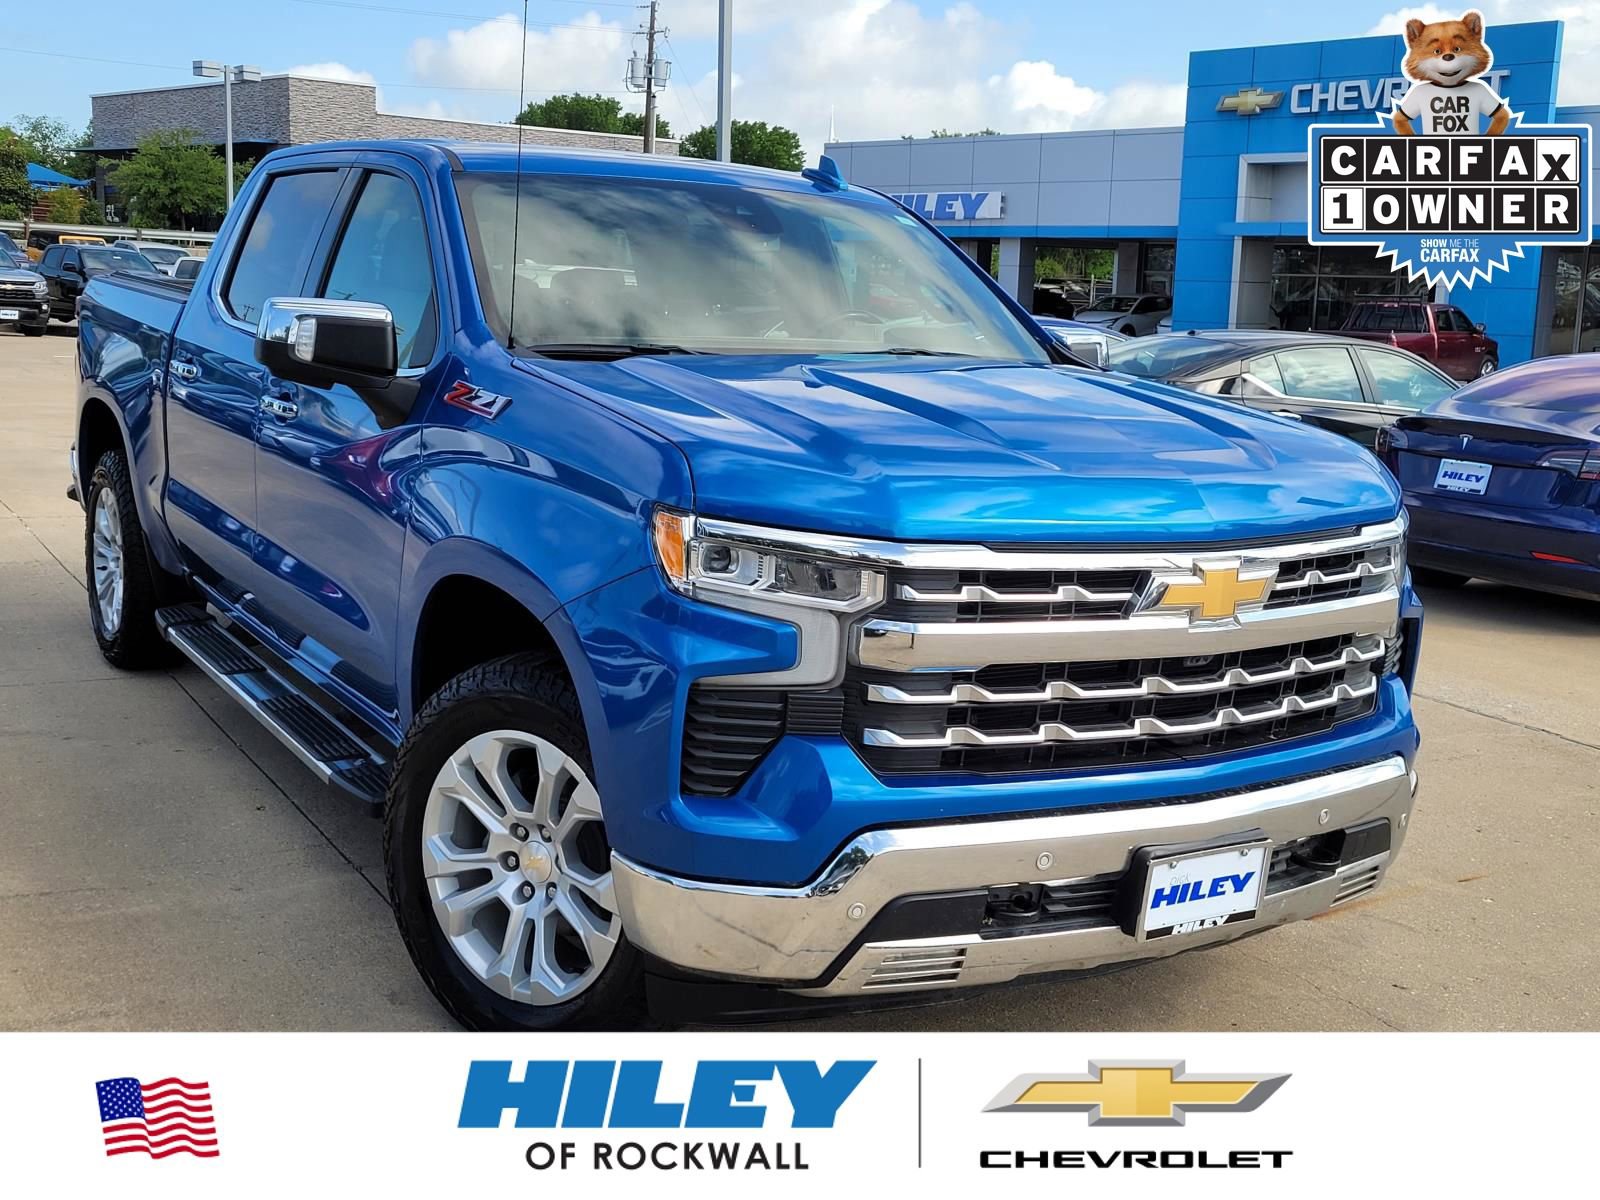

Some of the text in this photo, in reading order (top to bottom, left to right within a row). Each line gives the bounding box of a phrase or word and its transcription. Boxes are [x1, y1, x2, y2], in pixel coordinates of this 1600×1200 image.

[1290, 69, 1511, 114] CHEVRT
[1442, 470, 1485, 483] HILEY
[1151, 871, 1255, 909] HILEY
[1171, 914, 1230, 935] HILEY
